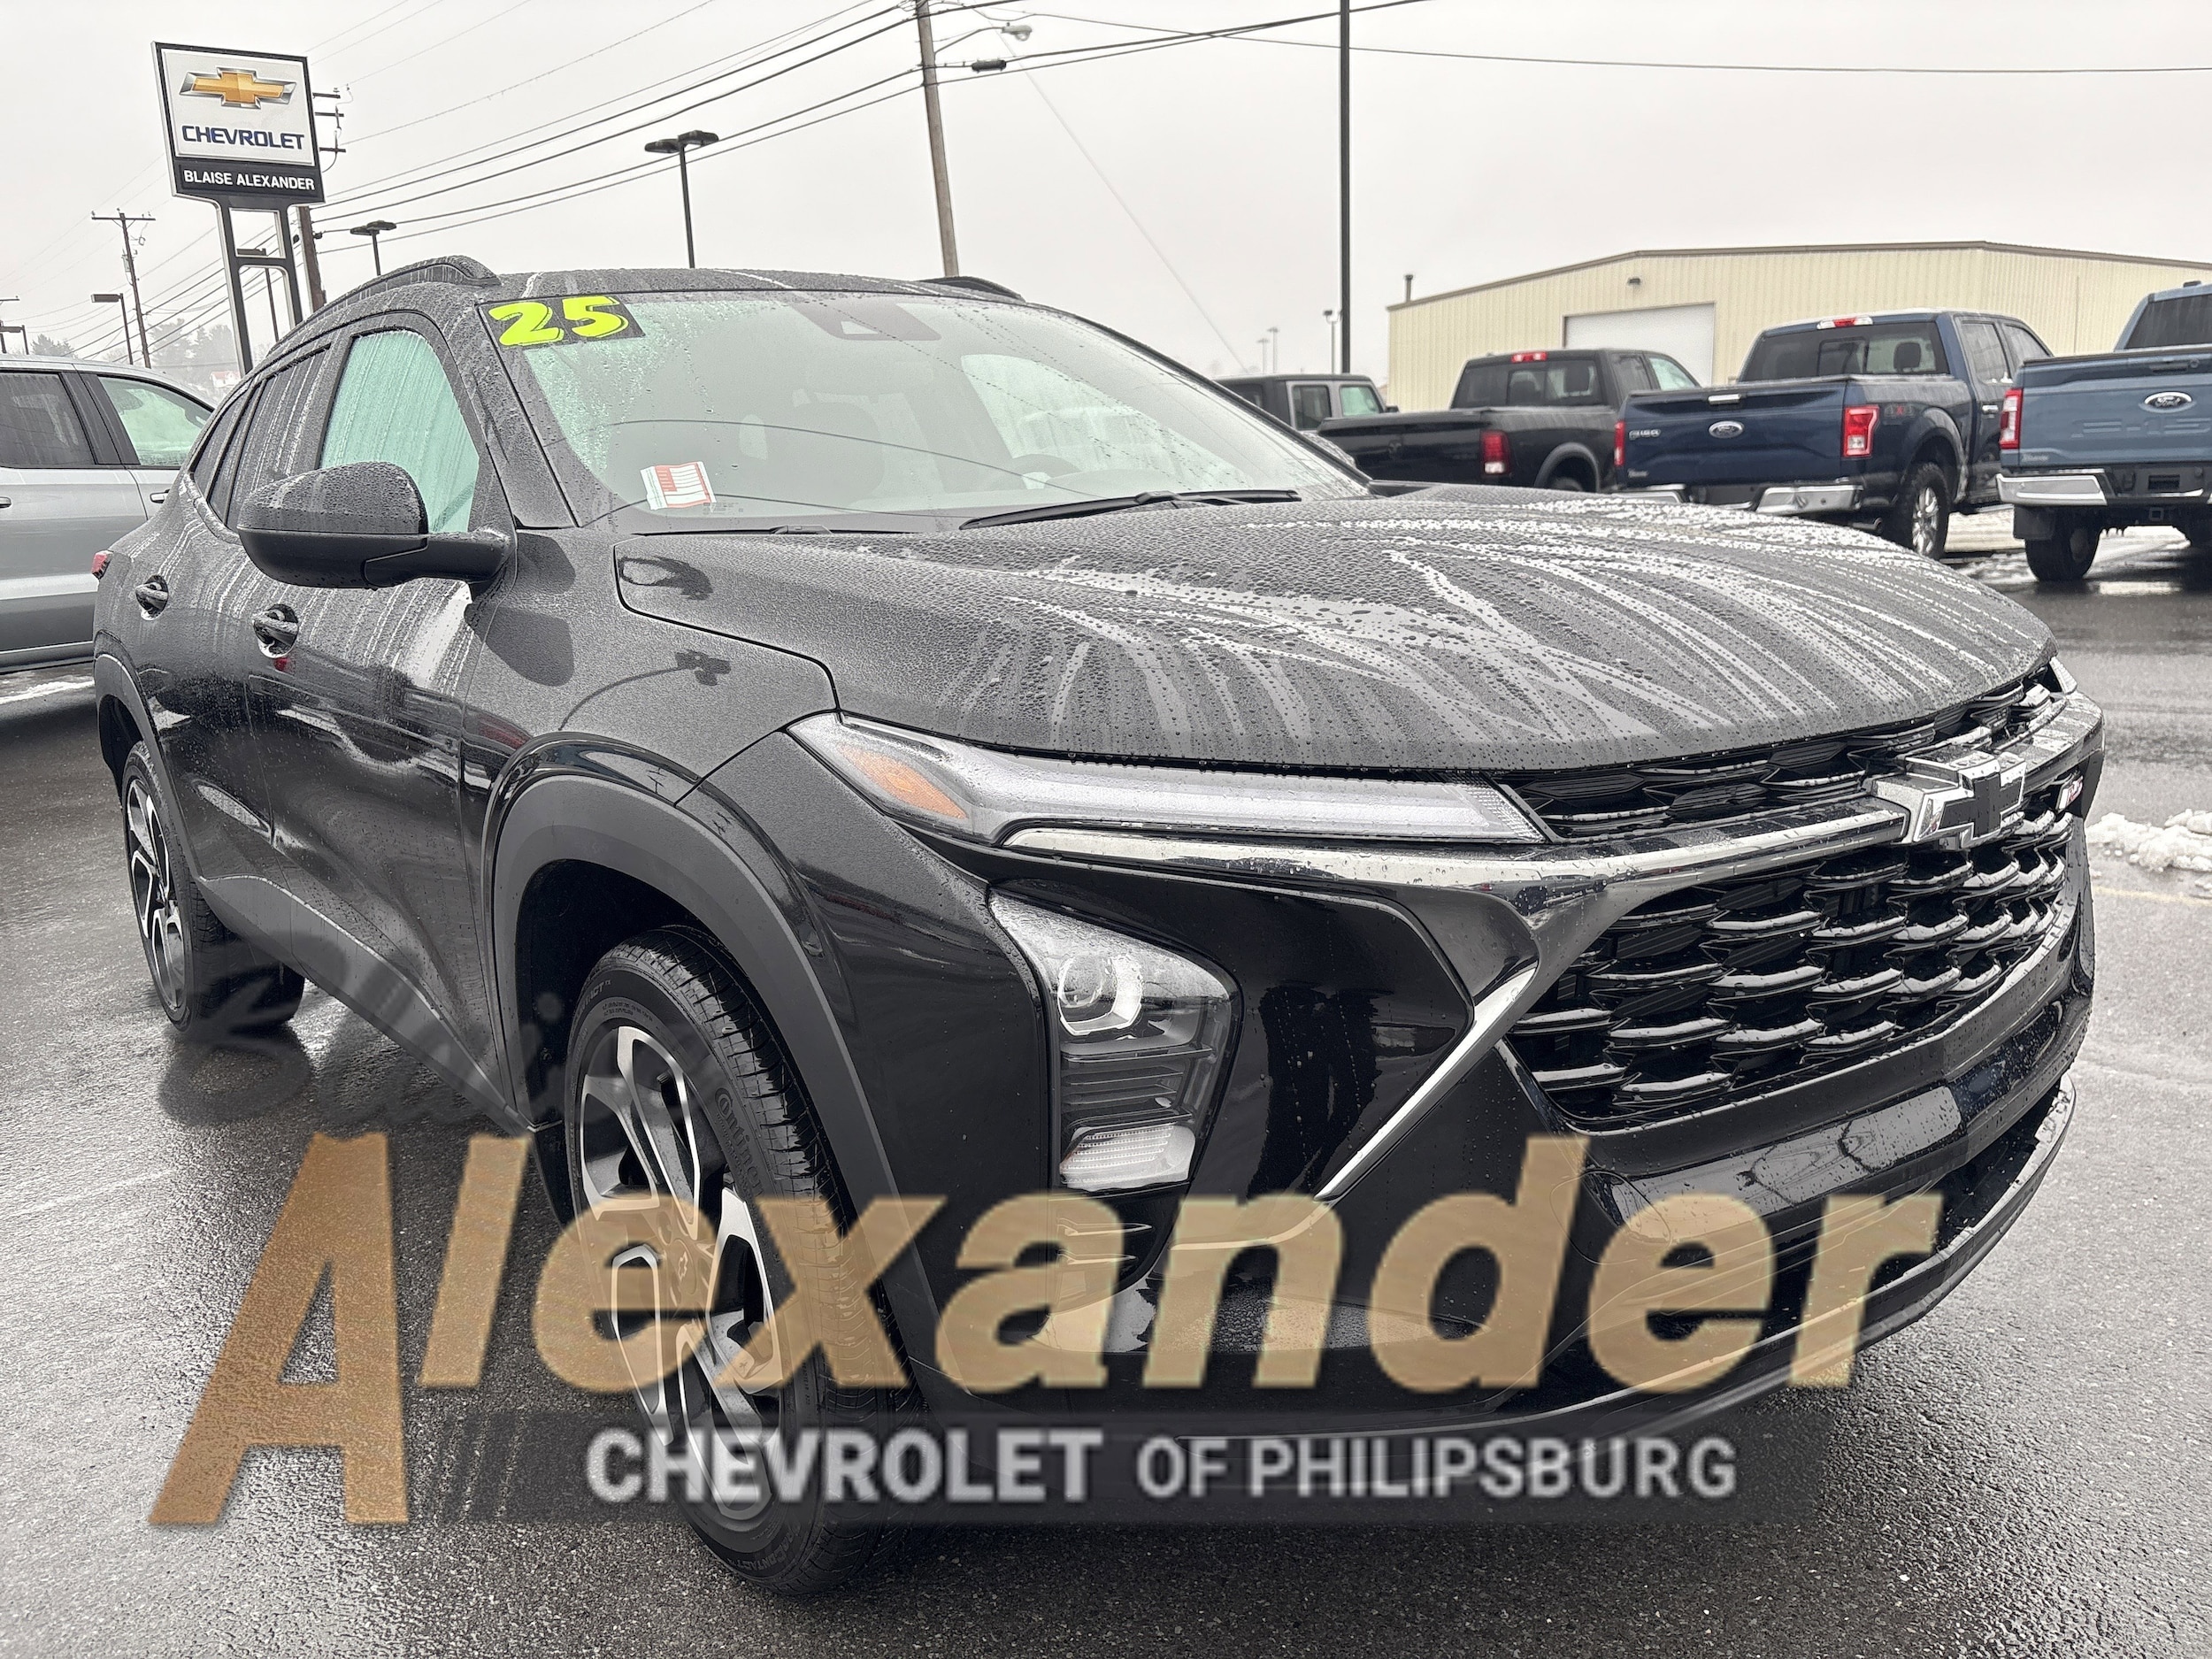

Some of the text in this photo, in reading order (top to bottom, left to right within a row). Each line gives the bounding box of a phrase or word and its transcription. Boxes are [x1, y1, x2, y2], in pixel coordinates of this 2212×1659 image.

[181, 125, 304, 150] CHEVROLET
[183, 169, 315, 190] BLAISE ALEXANDER
[488, 296, 629, 345] 25
